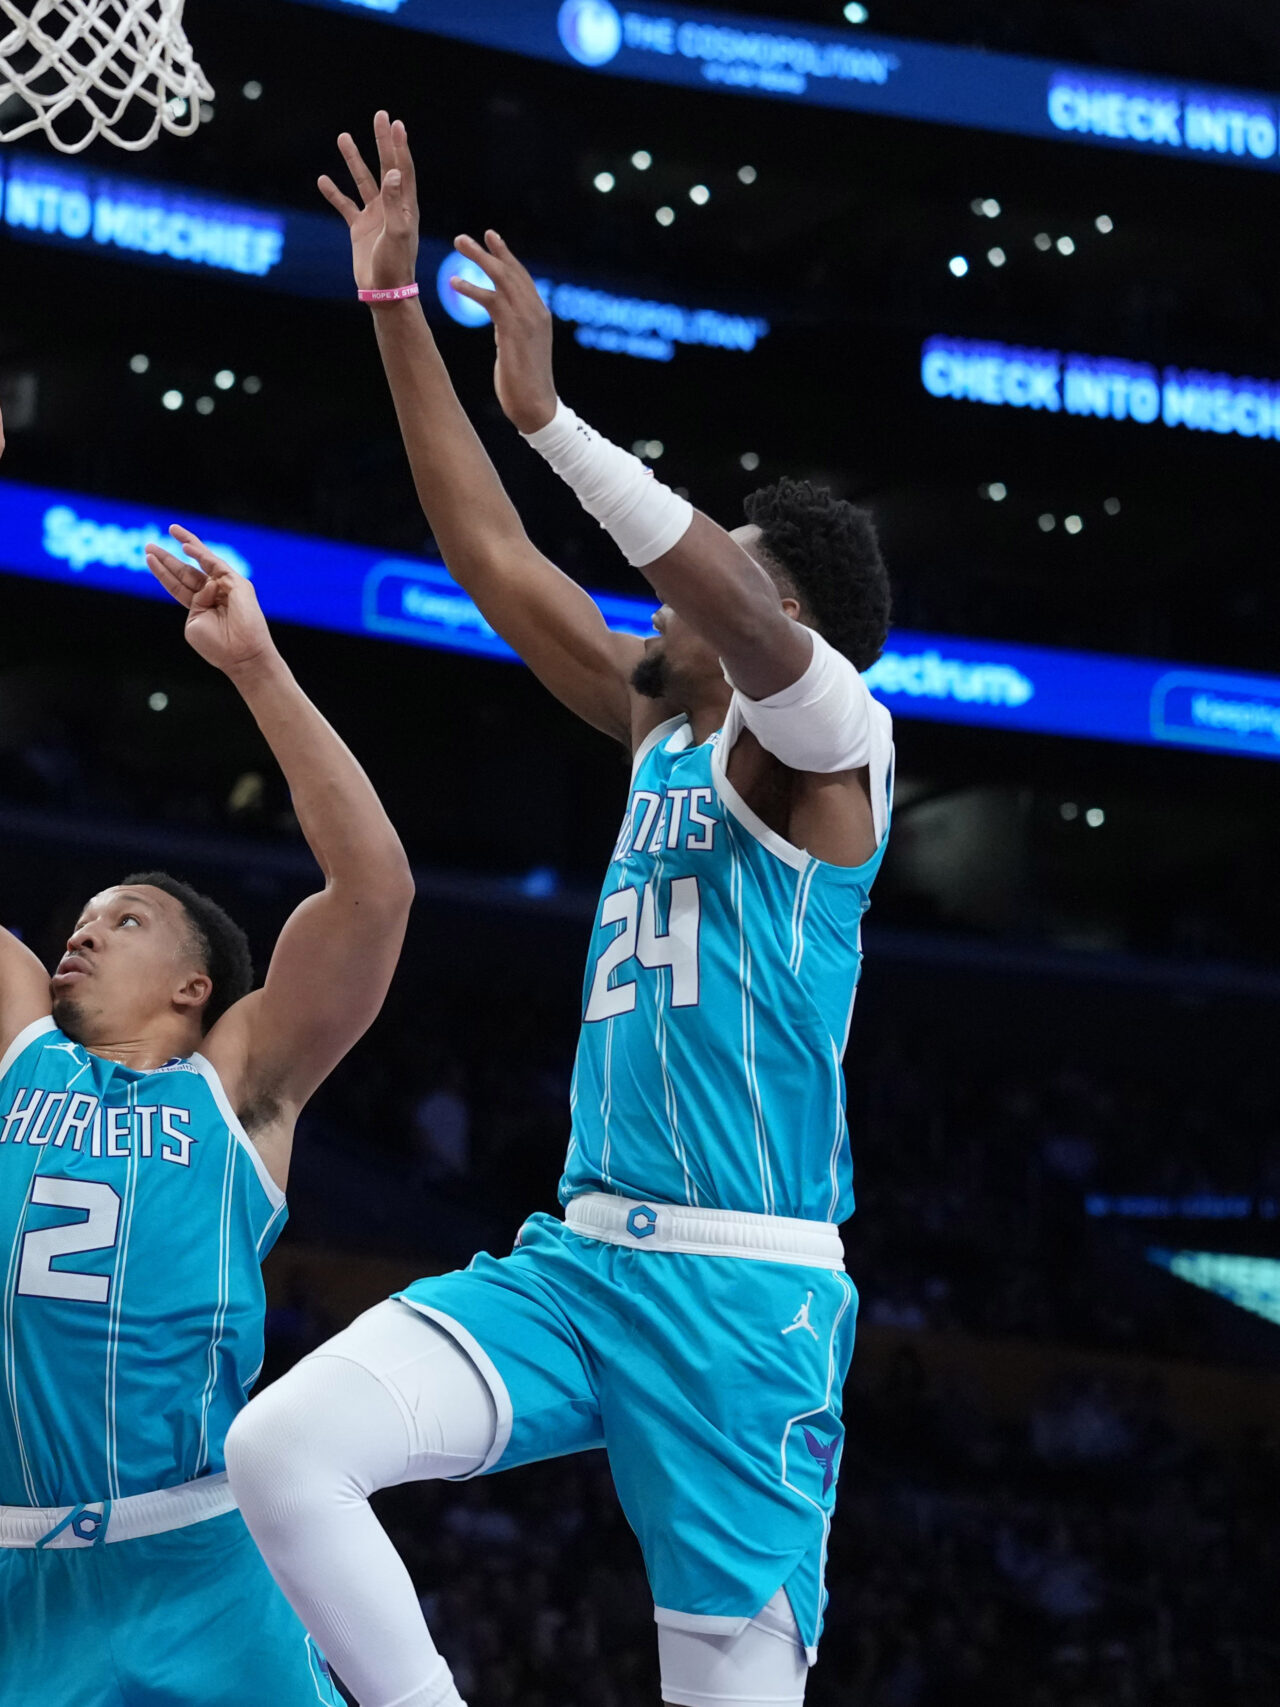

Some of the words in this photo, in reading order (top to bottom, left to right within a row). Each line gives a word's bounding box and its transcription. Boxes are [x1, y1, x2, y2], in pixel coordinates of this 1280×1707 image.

[1048, 84, 1183, 147] CHECK
[1184, 102, 1277, 159] INTO
[92, 194, 284, 276] MISCHIEF
[921, 347, 1062, 412] CHECK
[1063, 364, 1160, 424] INTO
[582, 875, 701, 1023] 24
[17, 1174, 122, 1305] 2
